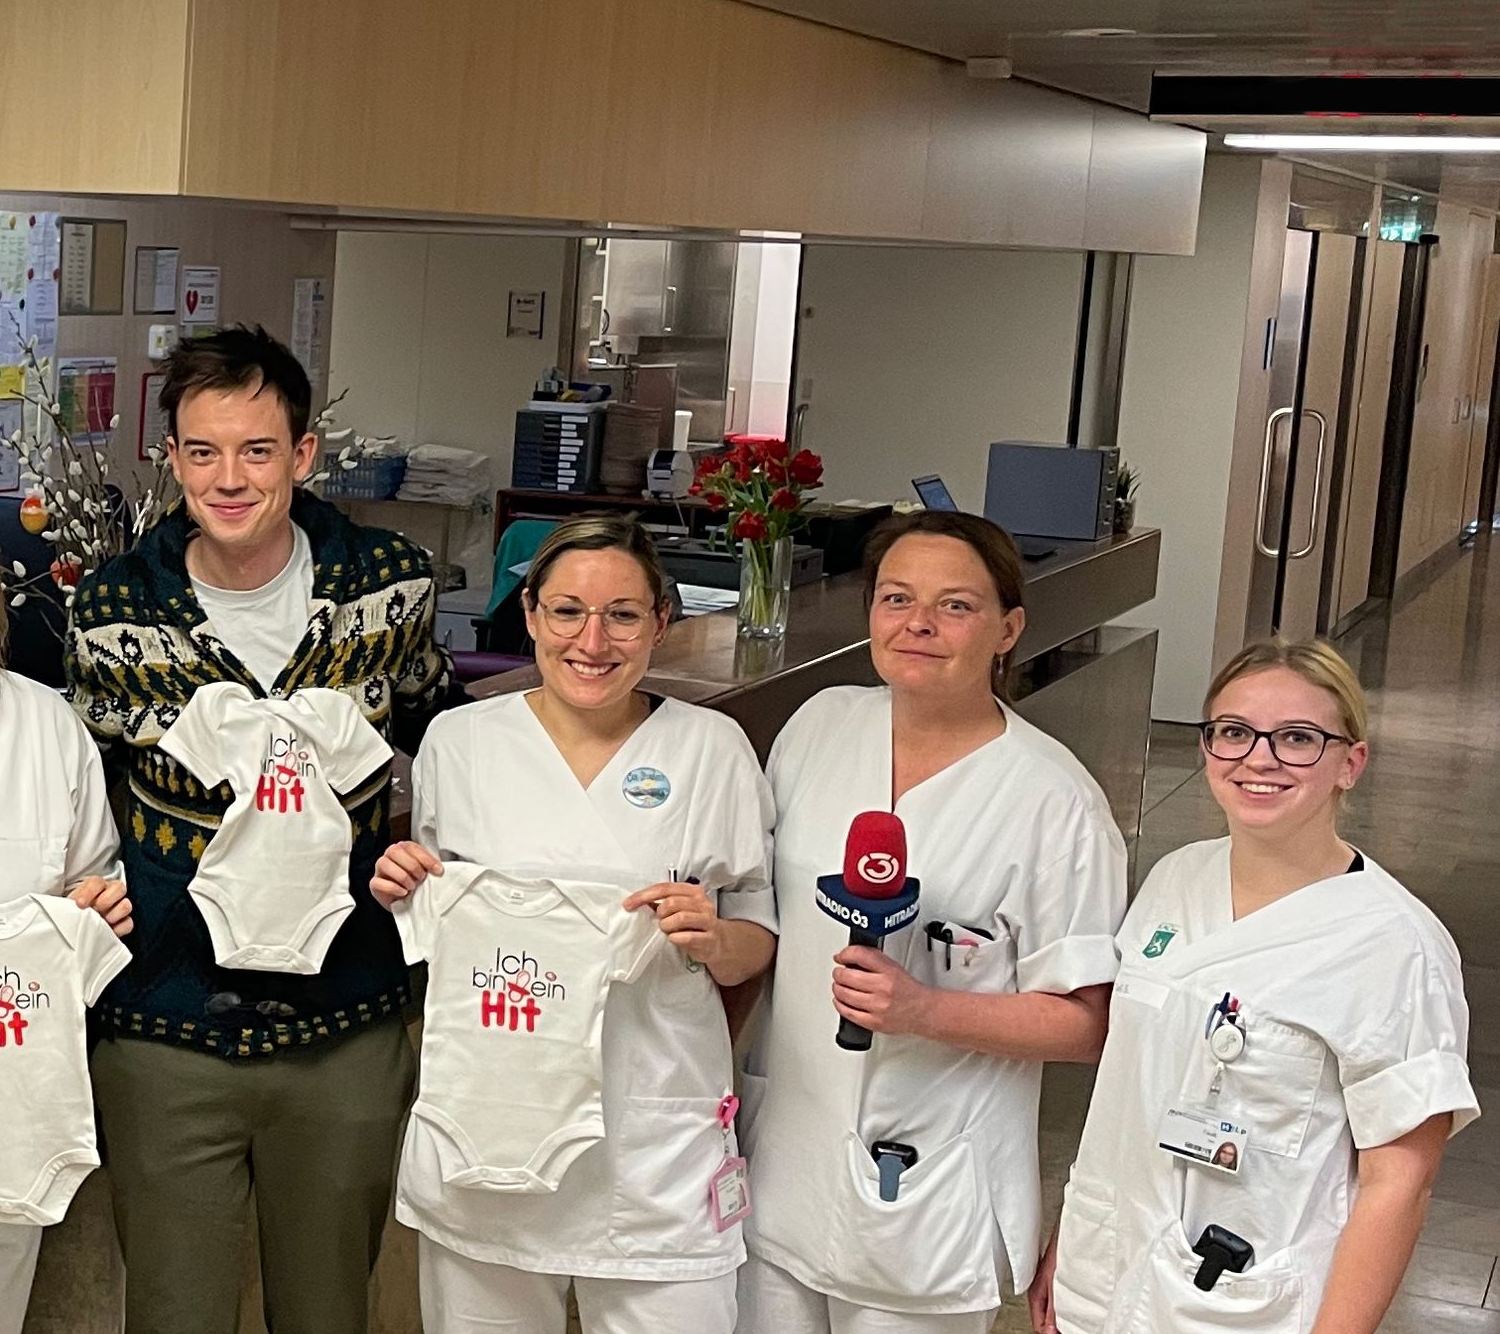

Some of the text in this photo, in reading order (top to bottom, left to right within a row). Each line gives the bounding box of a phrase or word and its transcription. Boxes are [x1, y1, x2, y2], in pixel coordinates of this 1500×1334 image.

[257, 775, 305, 813] Hit
[495, 947, 538, 978] Ich
[15, 987, 50, 1009] ein
[472, 966, 566, 1001] bin ein
[482, 990, 542, 1033] Hit
